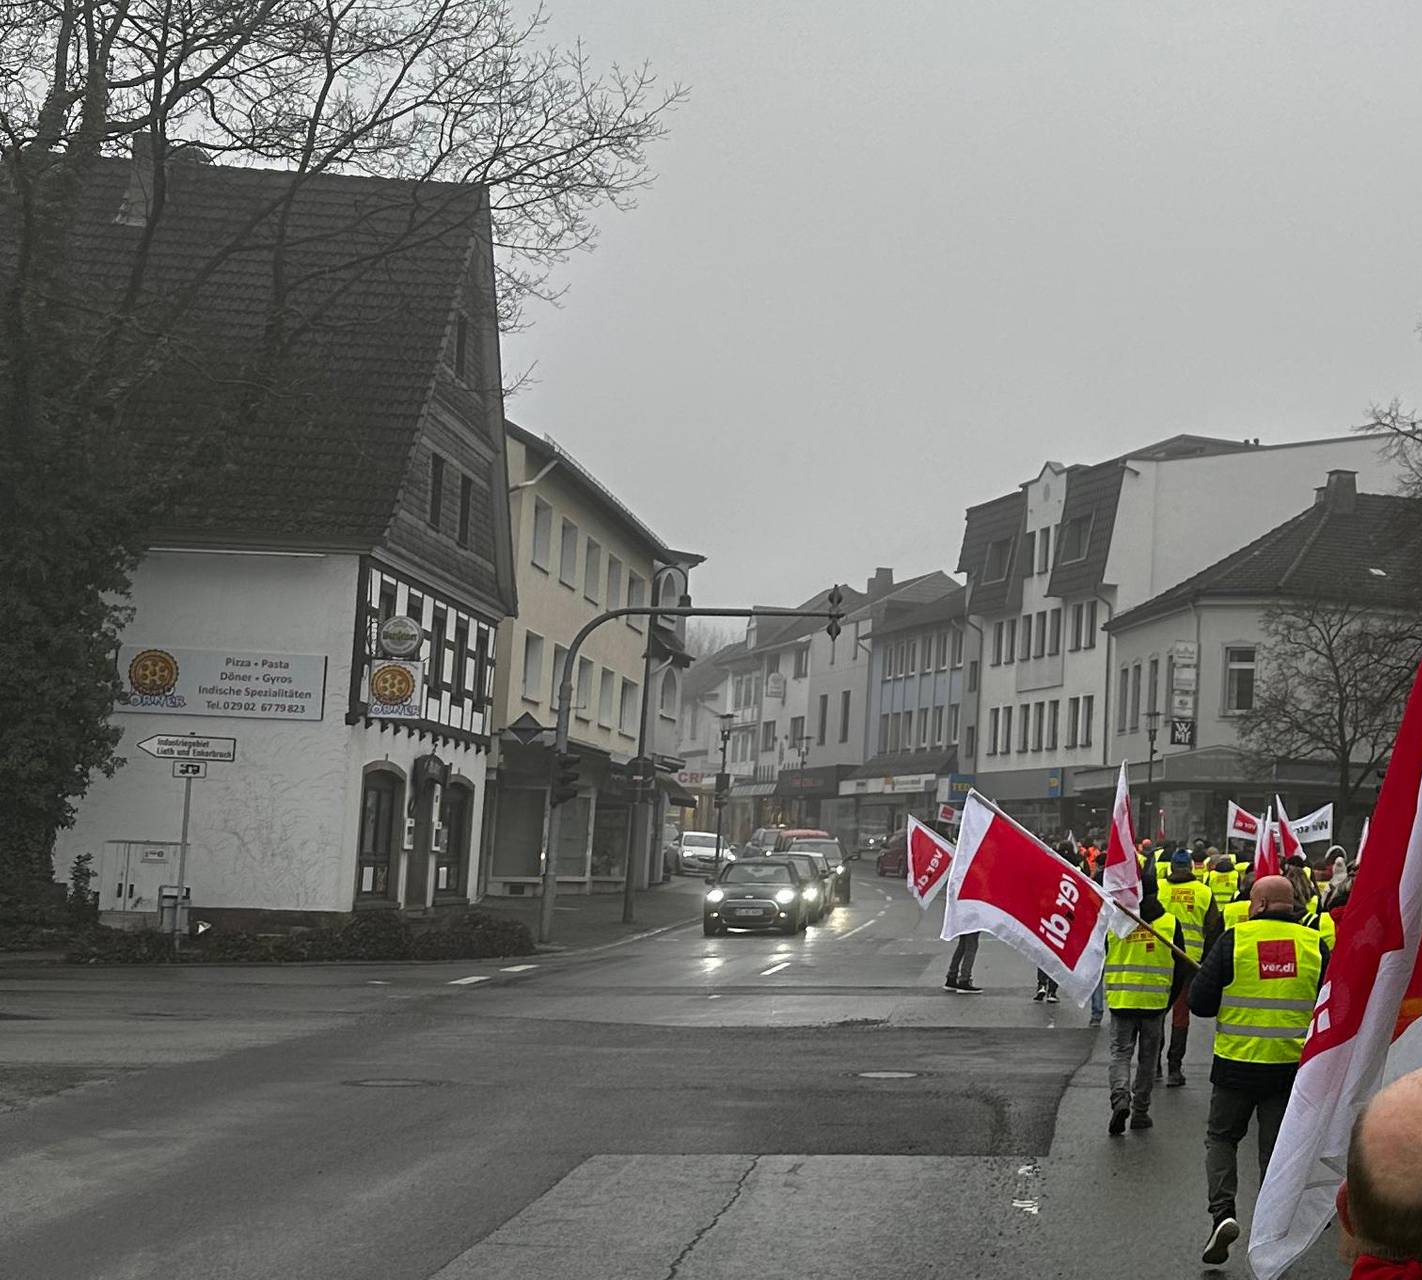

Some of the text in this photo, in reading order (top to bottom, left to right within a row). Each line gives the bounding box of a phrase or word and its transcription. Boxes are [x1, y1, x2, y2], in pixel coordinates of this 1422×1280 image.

[225, 657, 290, 669] Pizza Pasta
[220, 671, 293, 684] Döner Gyros
[199, 686, 312, 699] Indische Spezialitäten
[1261, 962, 1295, 973] ver.di
